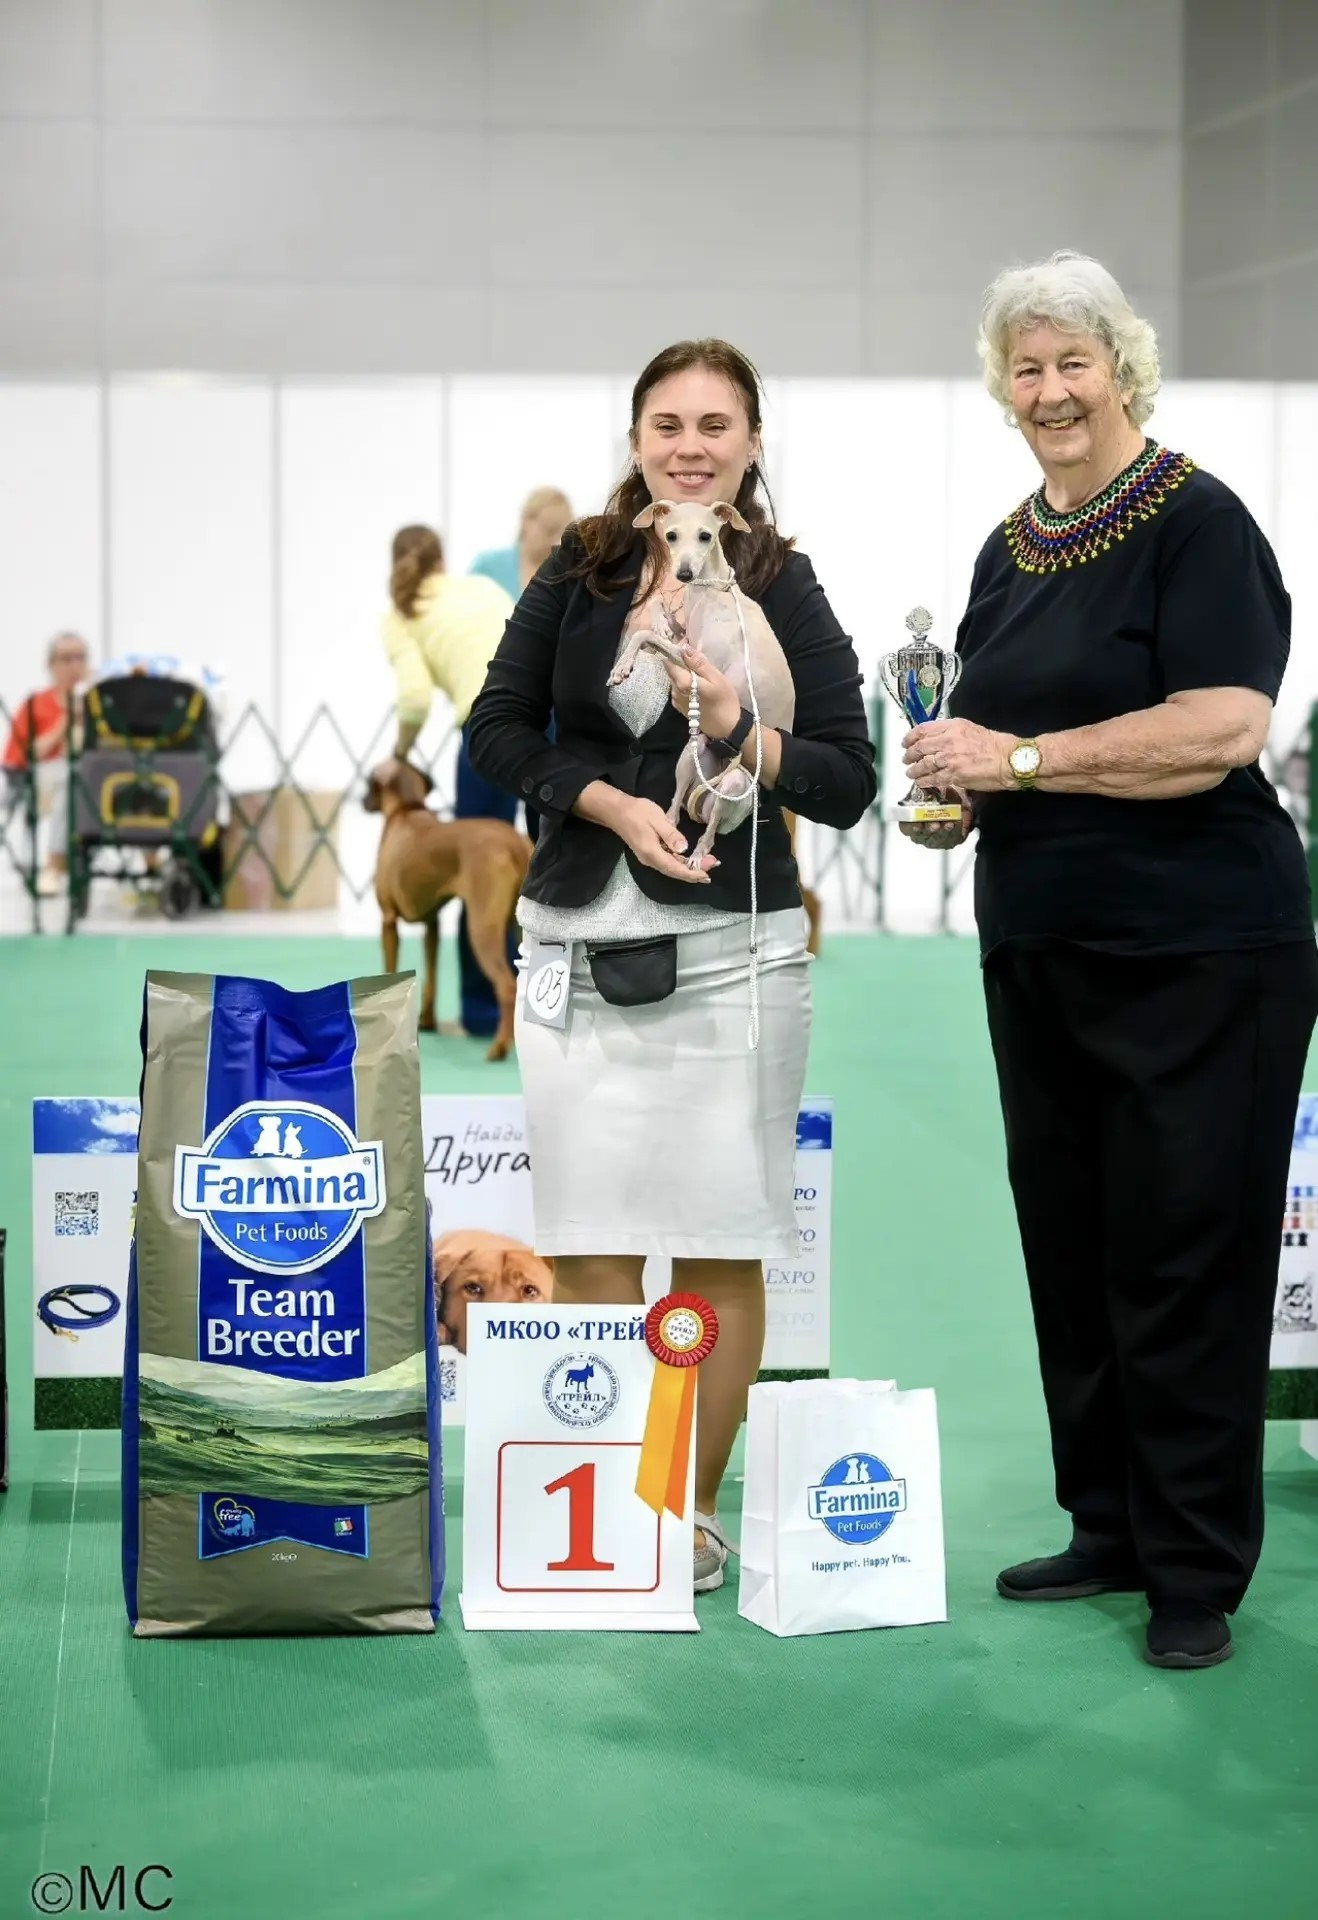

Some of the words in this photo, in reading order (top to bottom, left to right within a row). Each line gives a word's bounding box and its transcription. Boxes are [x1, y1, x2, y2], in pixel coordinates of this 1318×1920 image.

[463, 1122, 524, 1144] Найди
[424, 1136, 531, 1186] Друга
[794, 1188, 817, 1201] PO
[236, 1220, 269, 1242] Pet
[274, 1221, 328, 1242] Foods
[229, 1279, 335, 1318] Team
[207, 1318, 360, 1356] Breeder
[486, 1319, 561, 1341] МКОО
[567, 1316, 646, 1342] «ТРЕЙ
[544, 1463, 615, 1572] 1
[838, 1521, 853, 1534] Pet
[856, 1519, 882, 1531] Foods
[812, 1560, 842, 1573] Happy
[863, 1556, 890, 1569] Happy
